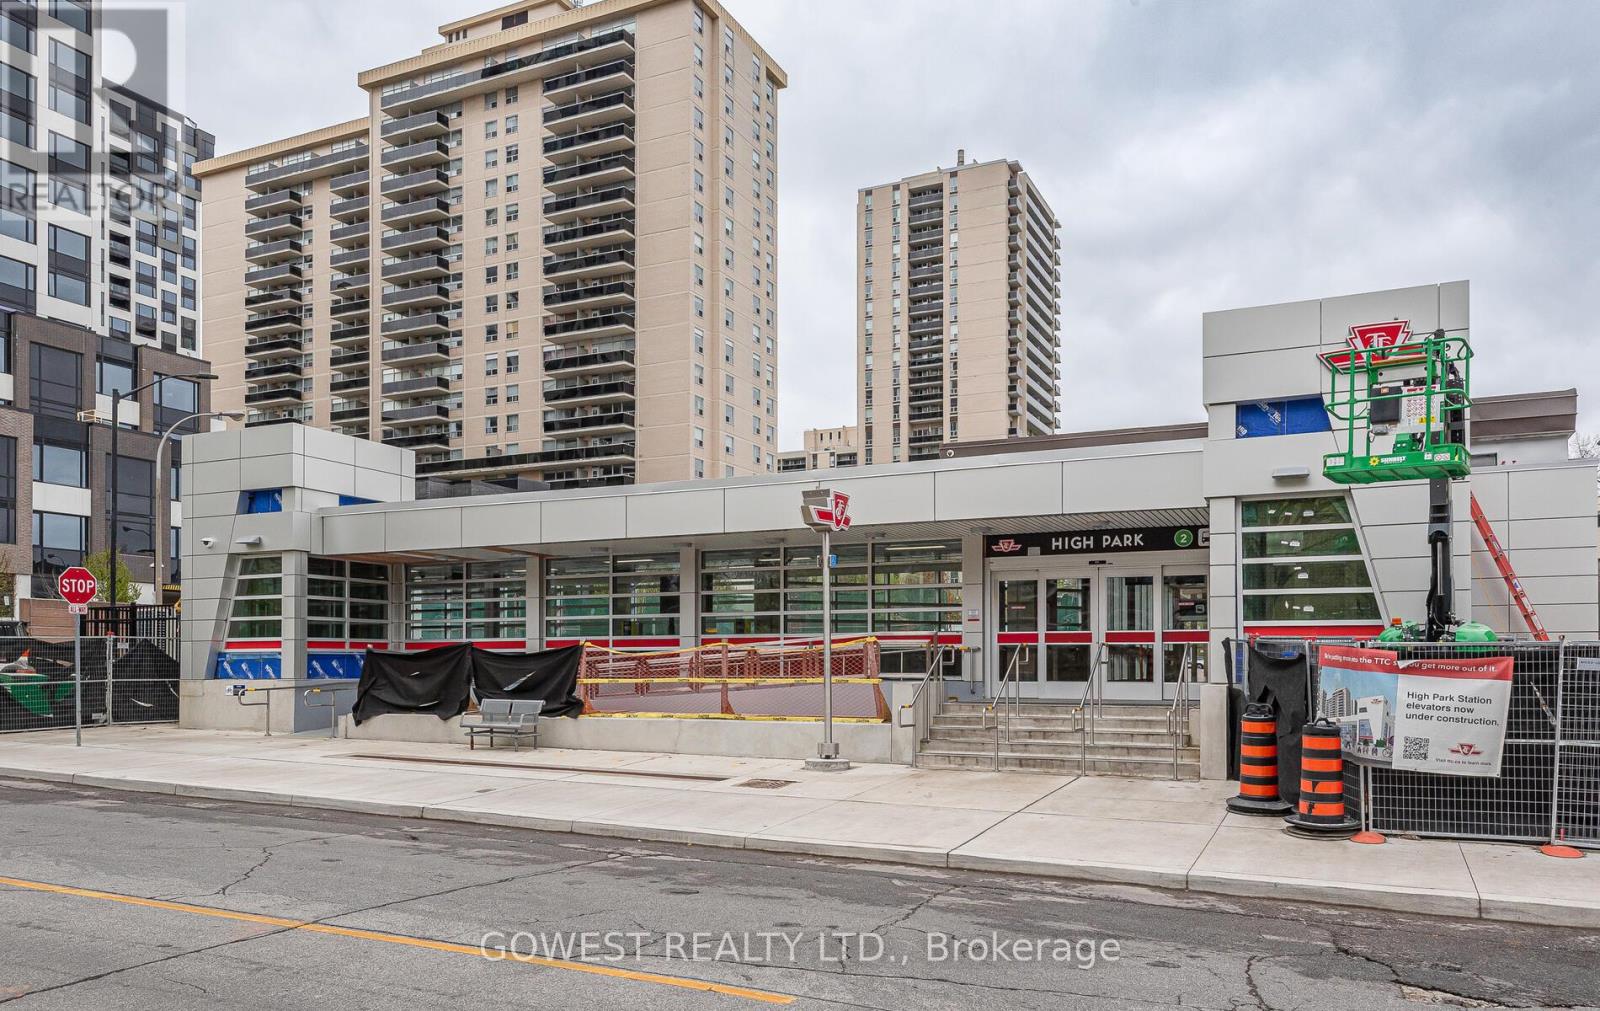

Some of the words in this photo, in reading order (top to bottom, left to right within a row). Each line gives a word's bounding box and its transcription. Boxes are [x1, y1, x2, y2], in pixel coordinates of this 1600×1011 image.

[1052, 536, 1094, 550] HIGH
[1102, 533, 1144, 548] PARK
[1180, 533, 1188, 544] 2
[62, 579, 95, 593] STOP
[1359, 656, 1373, 664] the
[1374, 657, 1391, 666] TTC
[1407, 691, 1429, 701] High
[1433, 693, 1455, 702] Park
[1458, 694, 1492, 704] Station
[1406, 702, 1451, 712] elevators
[1454, 706, 1474, 714] now
[1405, 712, 1434, 721] under
[1436, 715, 1499, 726] construction.
